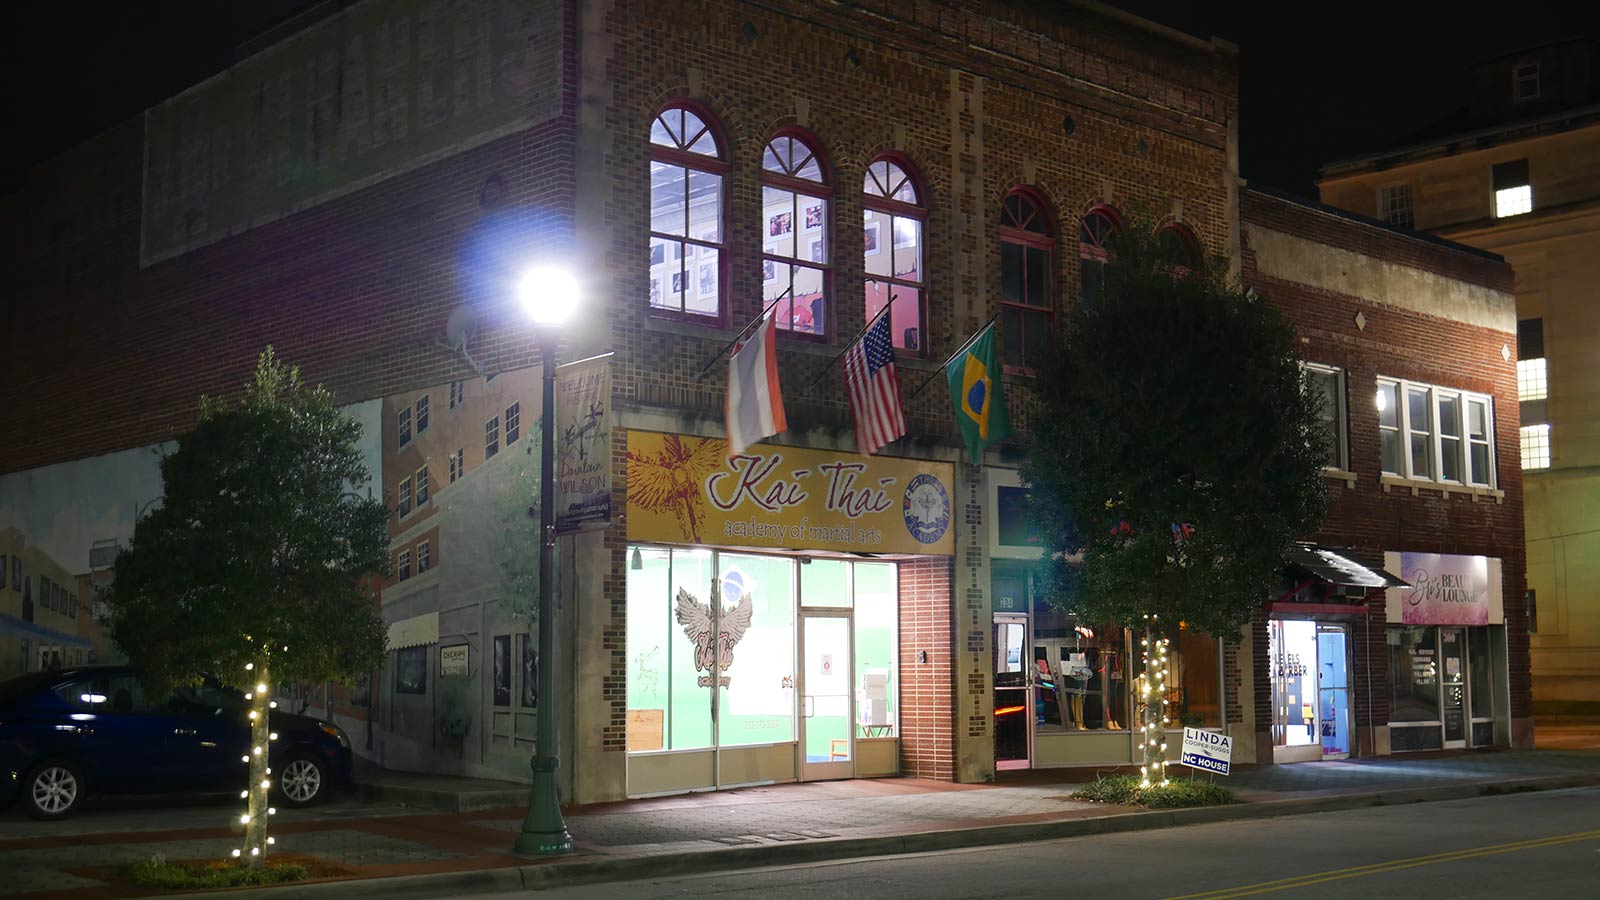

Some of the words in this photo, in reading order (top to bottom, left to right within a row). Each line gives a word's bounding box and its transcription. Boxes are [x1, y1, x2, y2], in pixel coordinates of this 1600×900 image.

[560, 473, 606, 495] WILSON
[707, 455, 806, 511] Kai
[819, 462, 897, 518] Thai
[724, 516, 787, 544] academy
[790, 518, 808, 540] of
[809, 520, 856, 543] martial
[858, 526, 882, 544] arts
[1442, 587, 1478, 603] LOUNGE
[697, 675, 731, 690] acadmy
[1184, 739, 1230, 754] COOPER-SUGGS
[1187, 728, 1229, 748] LINDA
[1184, 752, 1197, 764] NC
[1197, 757, 1228, 772] HOUSE
